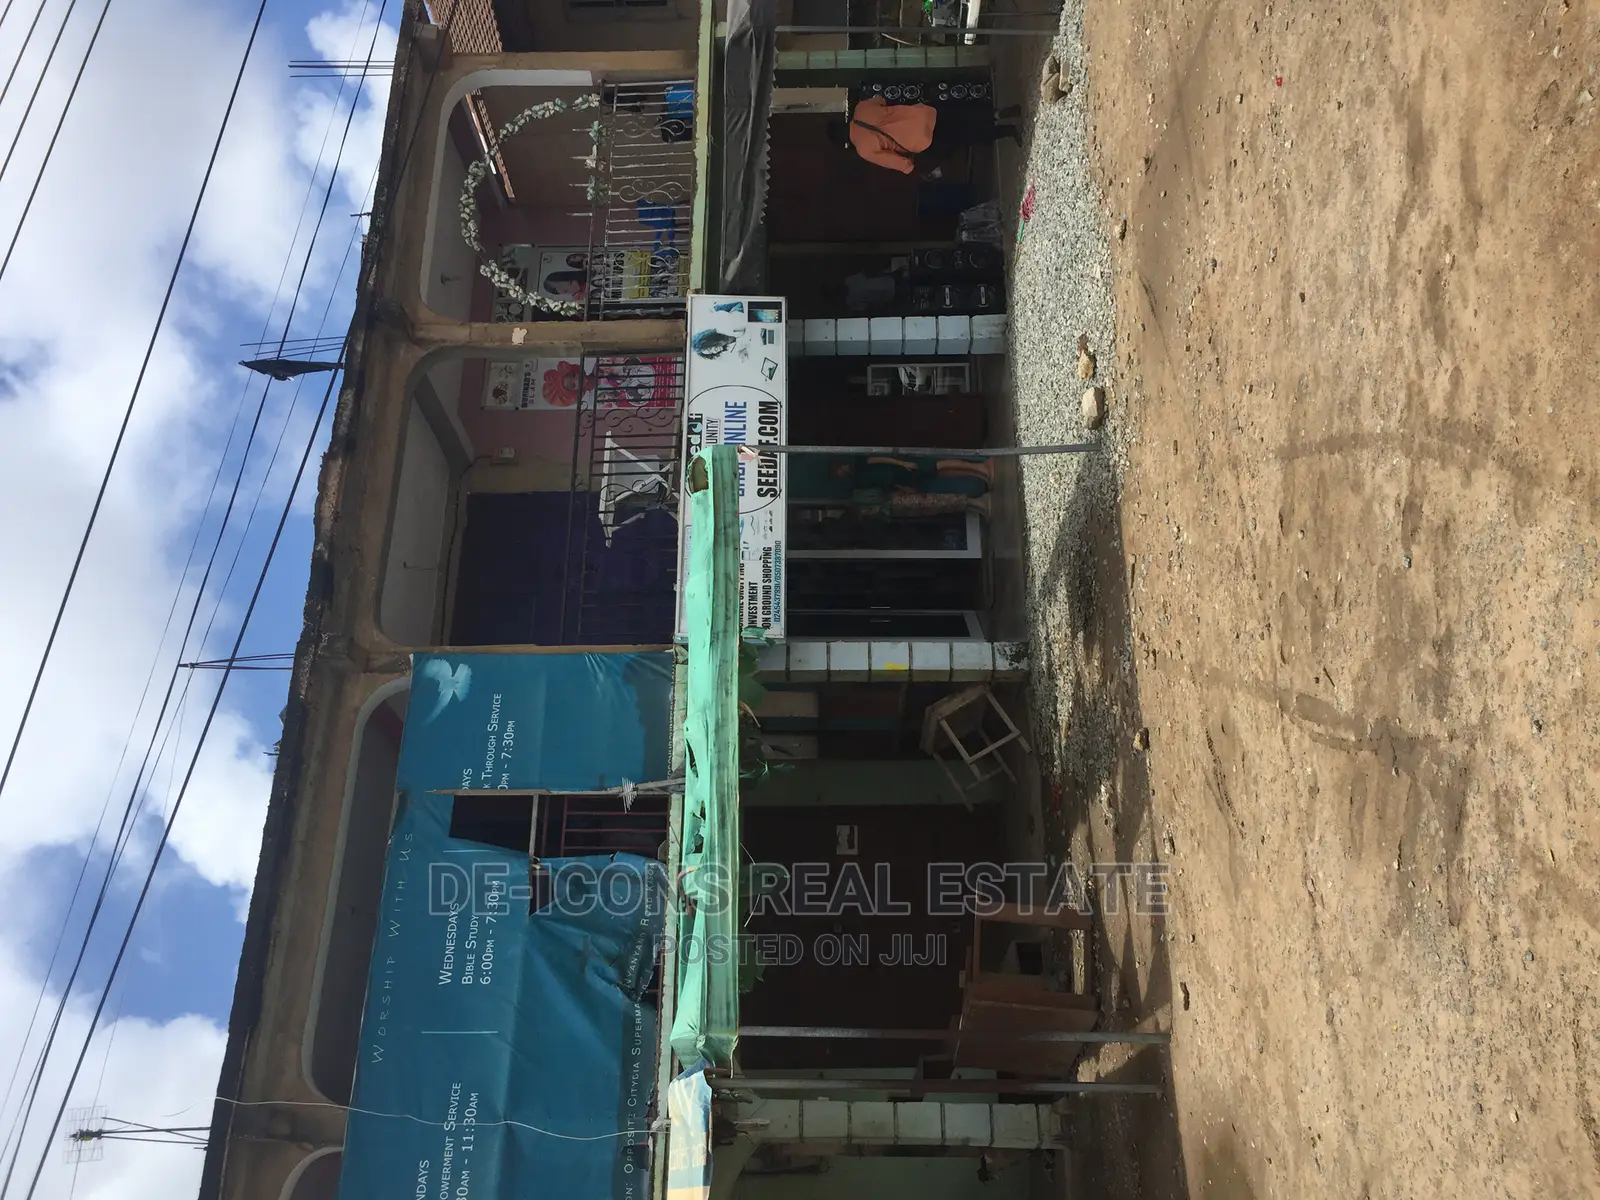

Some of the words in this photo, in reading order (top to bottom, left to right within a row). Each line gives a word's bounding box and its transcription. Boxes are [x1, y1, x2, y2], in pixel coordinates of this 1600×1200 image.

[724, 402, 746, 445] NLINE
[757, 402, 778, 498] SEEDAF.COM
[762, 546, 772, 583] SHOPPING
[748, 582, 758, 626] INVESTMENT
[762, 585, 772, 616] GROUND
[762, 618, 772, 627] ON
[487, 694, 502, 732] SERVICE
[482, 736, 496, 780] THROUGH
[501, 720, 515, 759] 7:30PM
[486, 880, 500, 924] 7:30PM
[438, 902, 460, 985] WEDNESDAYS
[466, 914, 479, 949] STUDY
[372, 956, 396, 1062] WORSHIP
[388, 881, 406, 937] WITH
[462, 953, 475, 984] BIBLE
[480, 940, 494, 984] 6:00PM
[444, 1082, 461, 1130] SERVICE
[462, 1092, 478, 1152] 11:30AM
[440, 1136, 454, 1200] OWERMENT
